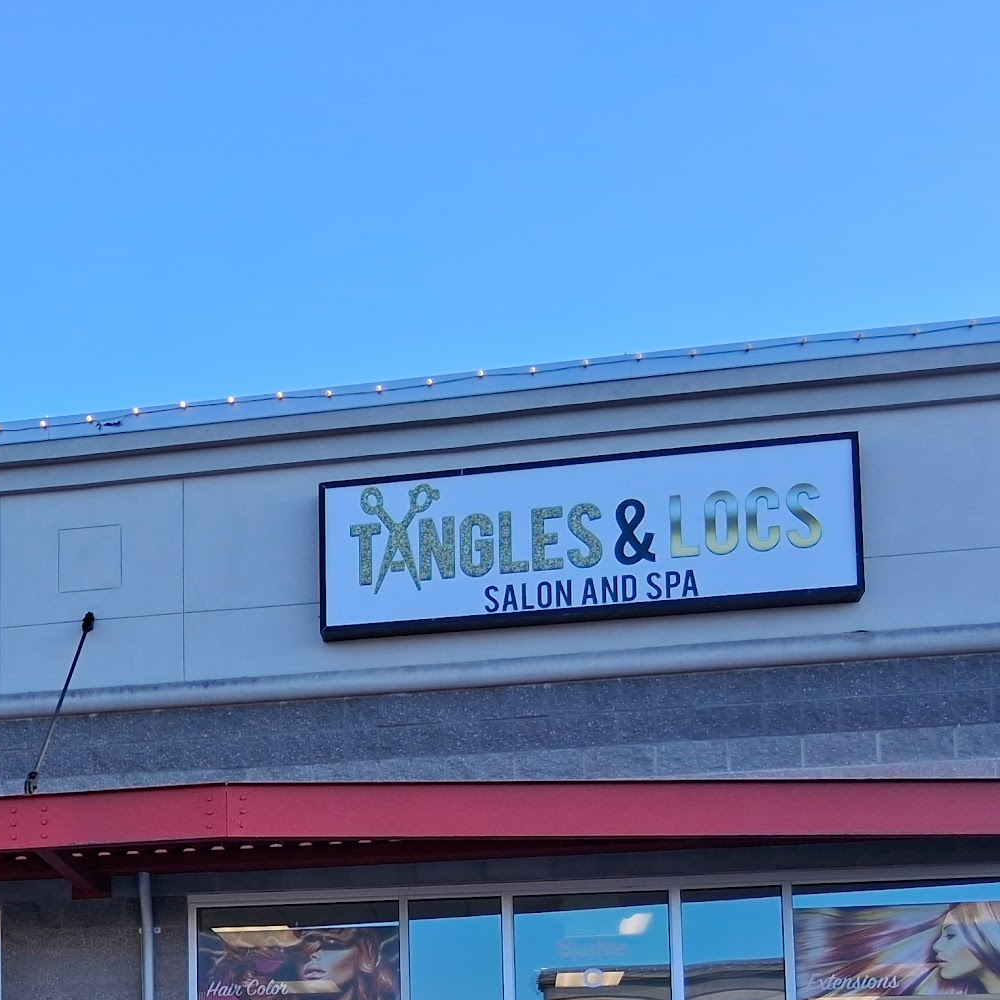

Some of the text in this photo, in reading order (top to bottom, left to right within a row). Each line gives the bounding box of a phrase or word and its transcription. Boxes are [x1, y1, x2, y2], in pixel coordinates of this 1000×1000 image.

[350, 483, 823, 594] TANGLES & LOCS
[484, 569, 700, 613] SALON AND SPA
[206, 979, 289, 998] Hair Color
[806, 972, 900, 991] Extensions
